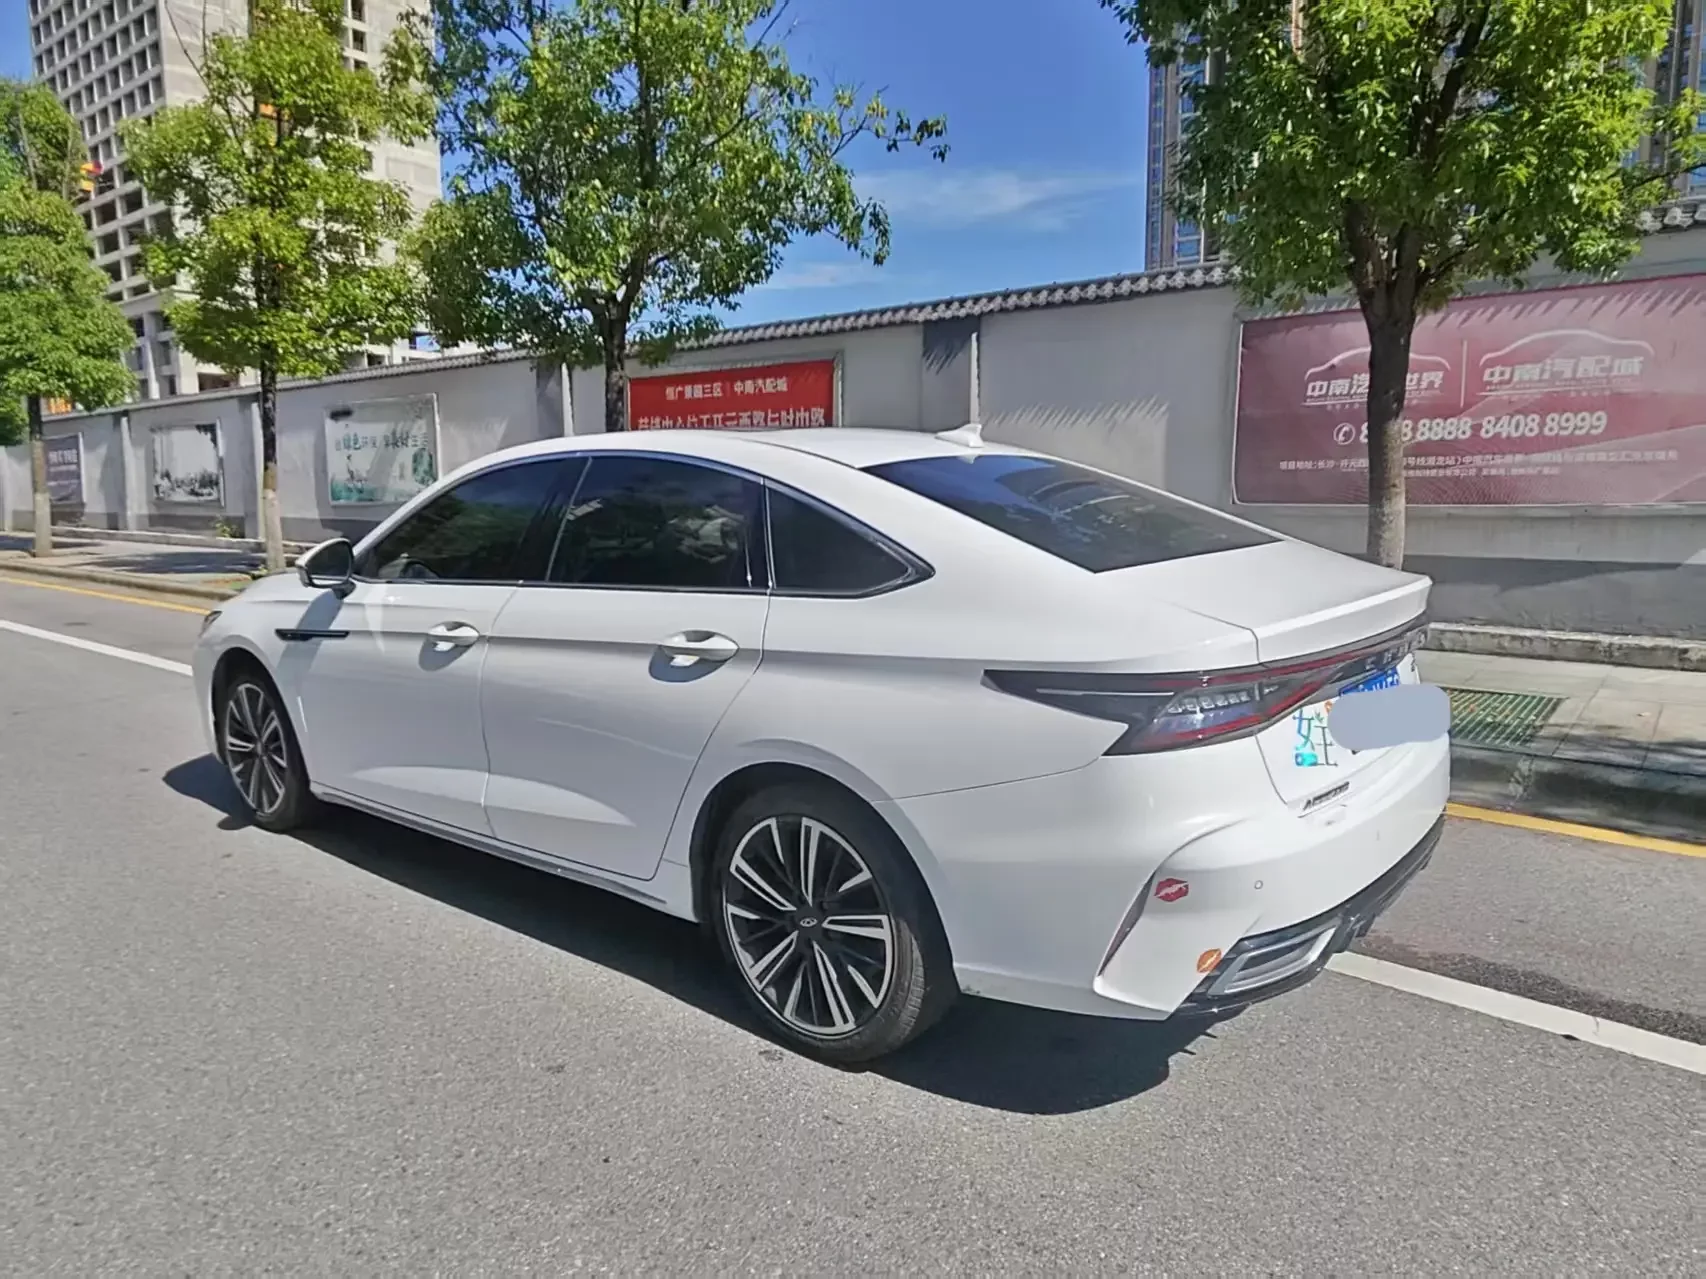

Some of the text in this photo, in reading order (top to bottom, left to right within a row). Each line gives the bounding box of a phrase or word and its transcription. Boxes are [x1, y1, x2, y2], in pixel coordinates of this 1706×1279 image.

[1483, 355, 1644, 383] 中南汽配城
[1306, 370, 1445, 397] 中南汽世界
[1416, 417, 1472, 441] 8888
[1480, 414, 1540, 440] 8408
[1543, 411, 1608, 437] 8999
